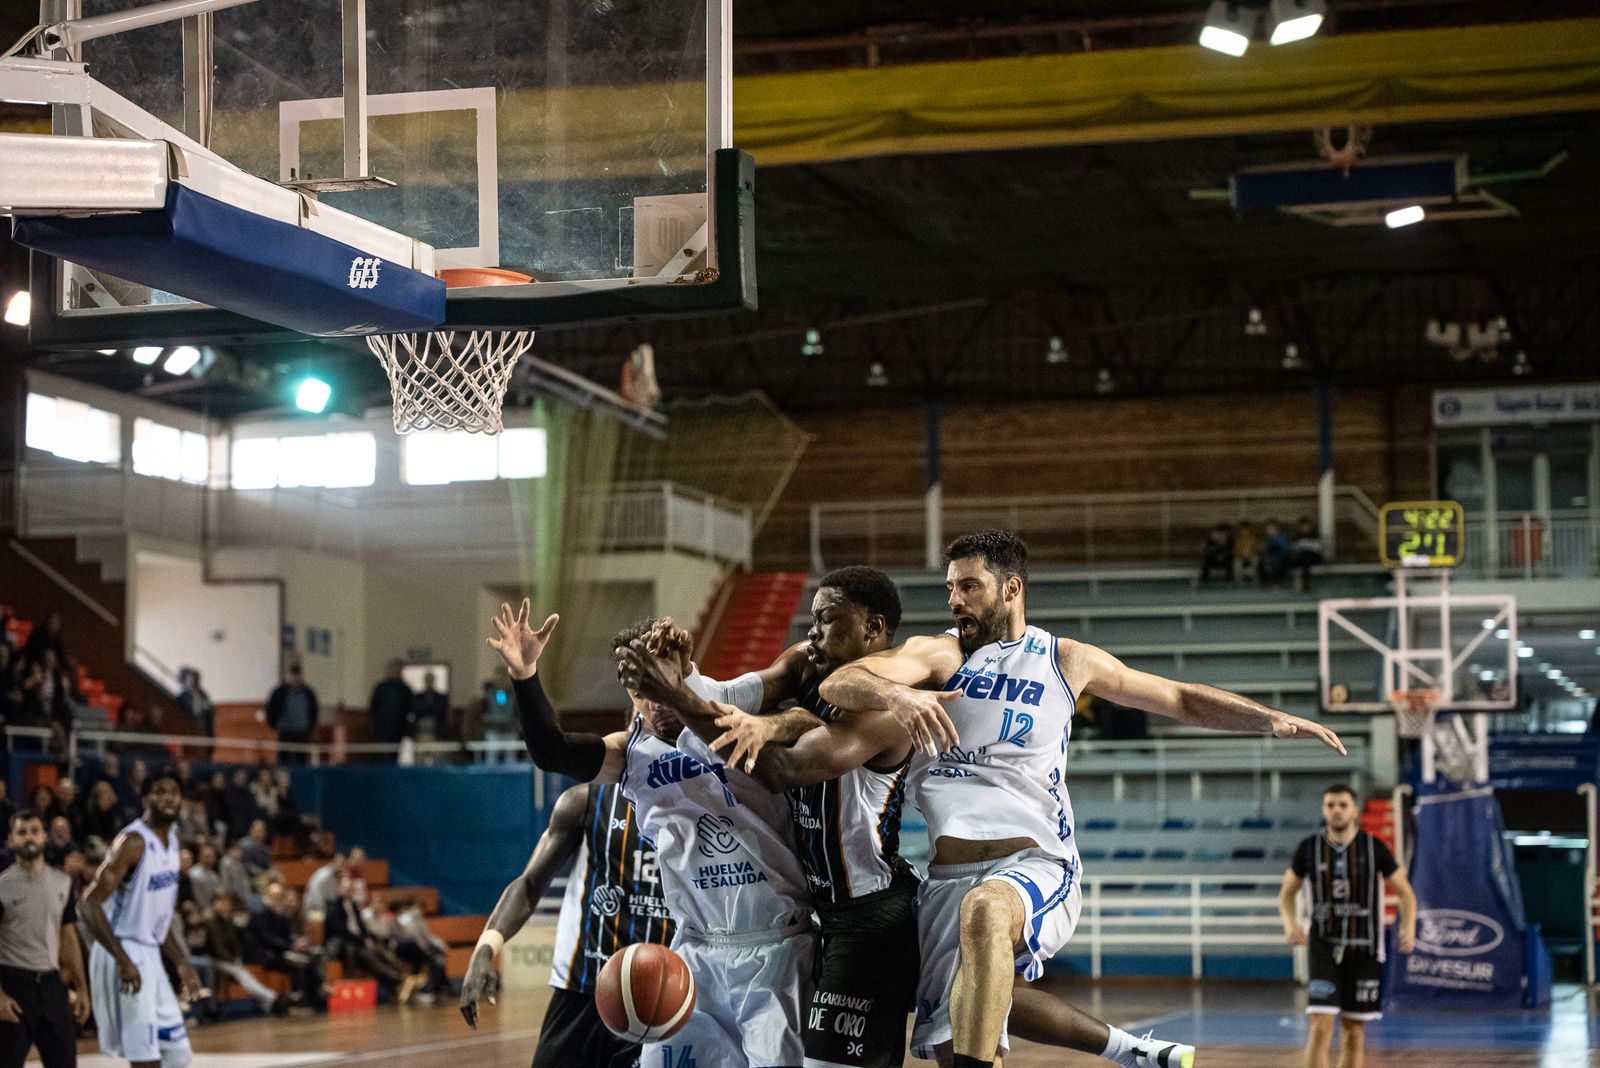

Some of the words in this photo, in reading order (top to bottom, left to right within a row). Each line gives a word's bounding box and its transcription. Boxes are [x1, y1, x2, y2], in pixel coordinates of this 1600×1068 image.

[348, 256, 382, 289] GES
[942, 673, 1045, 706] uelva
[998, 708, 1034, 748] 12
[633, 850, 659, 883] 12
[692, 878, 709, 889] TE
[710, 872, 767, 888] SALUDA
[699, 861, 753, 877] HUELVA
[629, 894, 667, 908] HUELV
[629, 905, 645, 915] TE
[646, 907, 670, 918] SAL
[808, 1007, 828, 1031] DE
[834, 1012, 866, 1038] ORO
